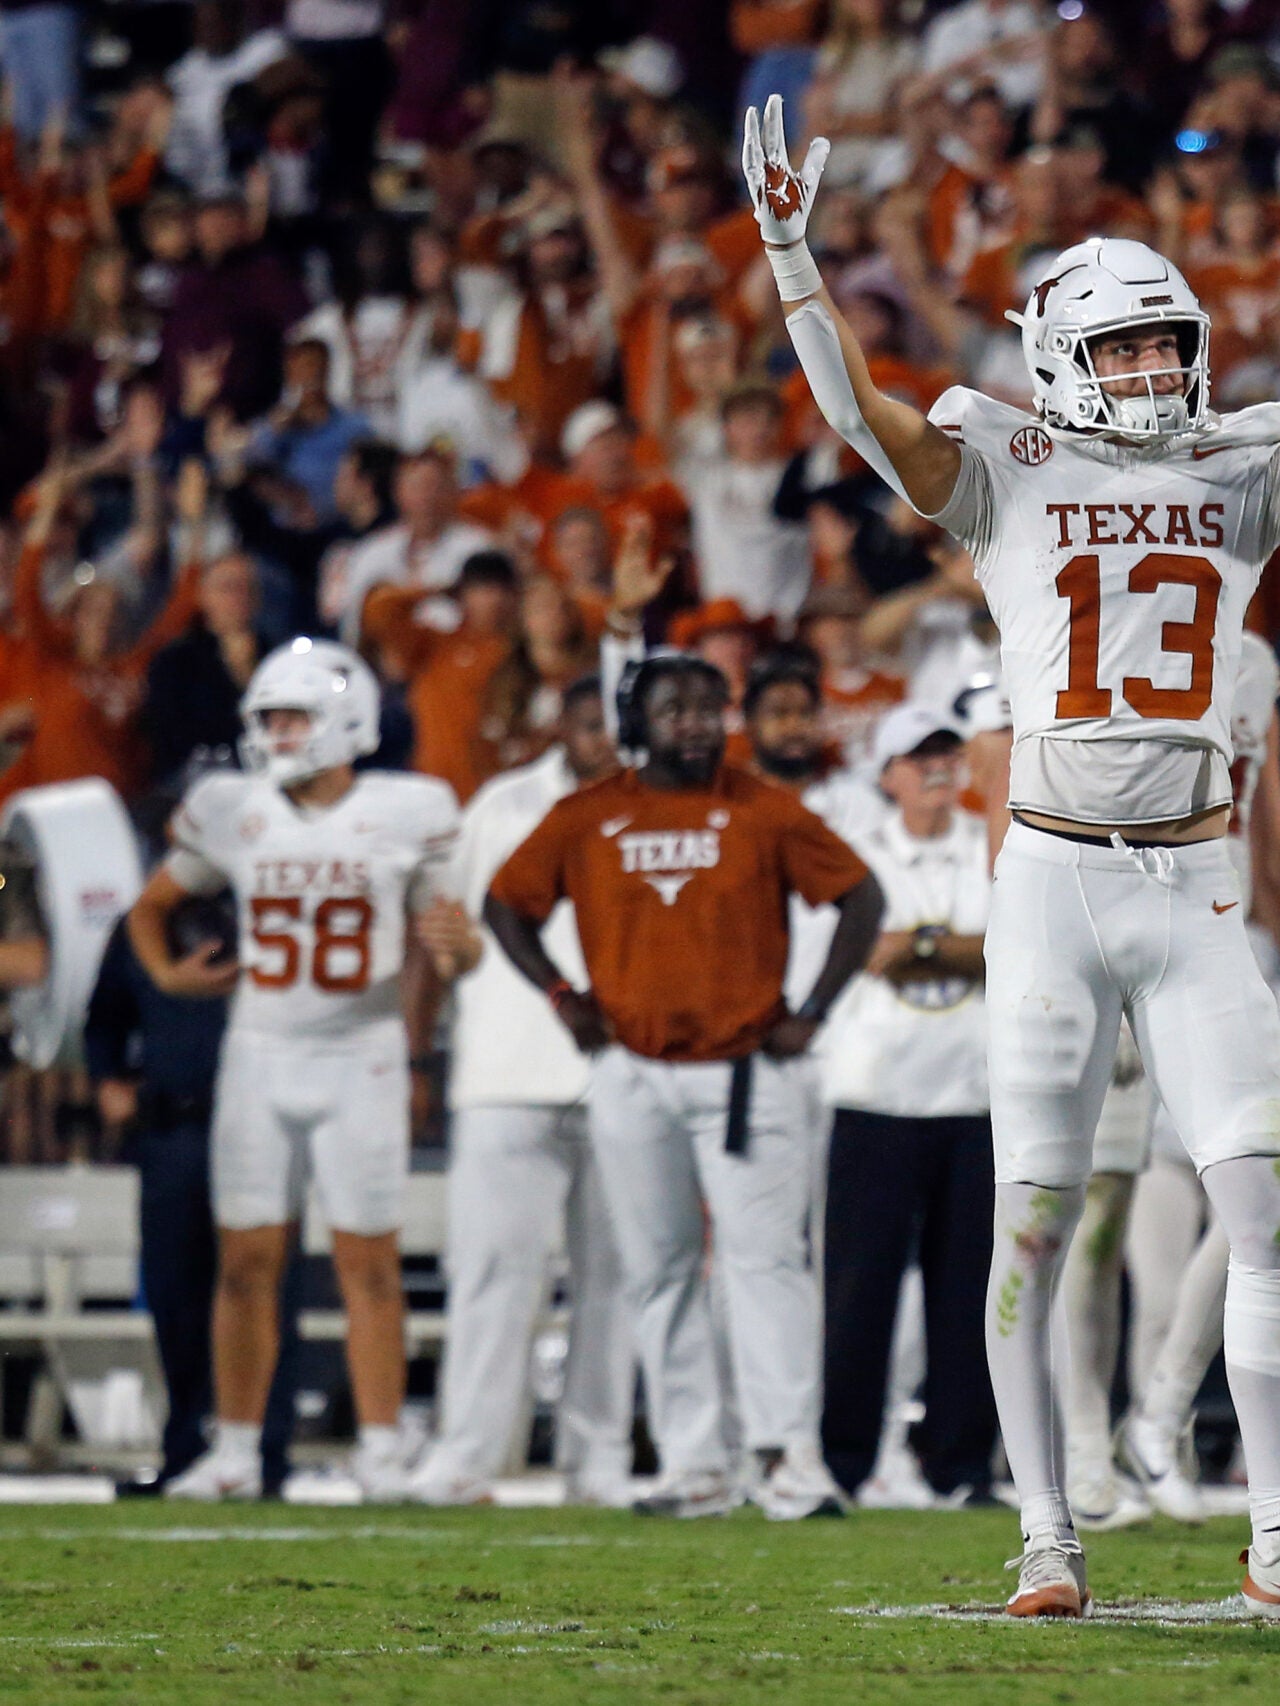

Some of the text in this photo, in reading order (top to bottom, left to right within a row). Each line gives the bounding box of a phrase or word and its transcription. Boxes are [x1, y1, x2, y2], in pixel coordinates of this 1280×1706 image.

[1010, 427, 1052, 465] SEC
[1046, 503, 1225, 548] TEXAS
[1054, 553, 1223, 721] 13
[617, 830, 721, 873] TEXAS
[254, 861, 372, 896] TEXAS
[250, 897, 374, 992] 58
